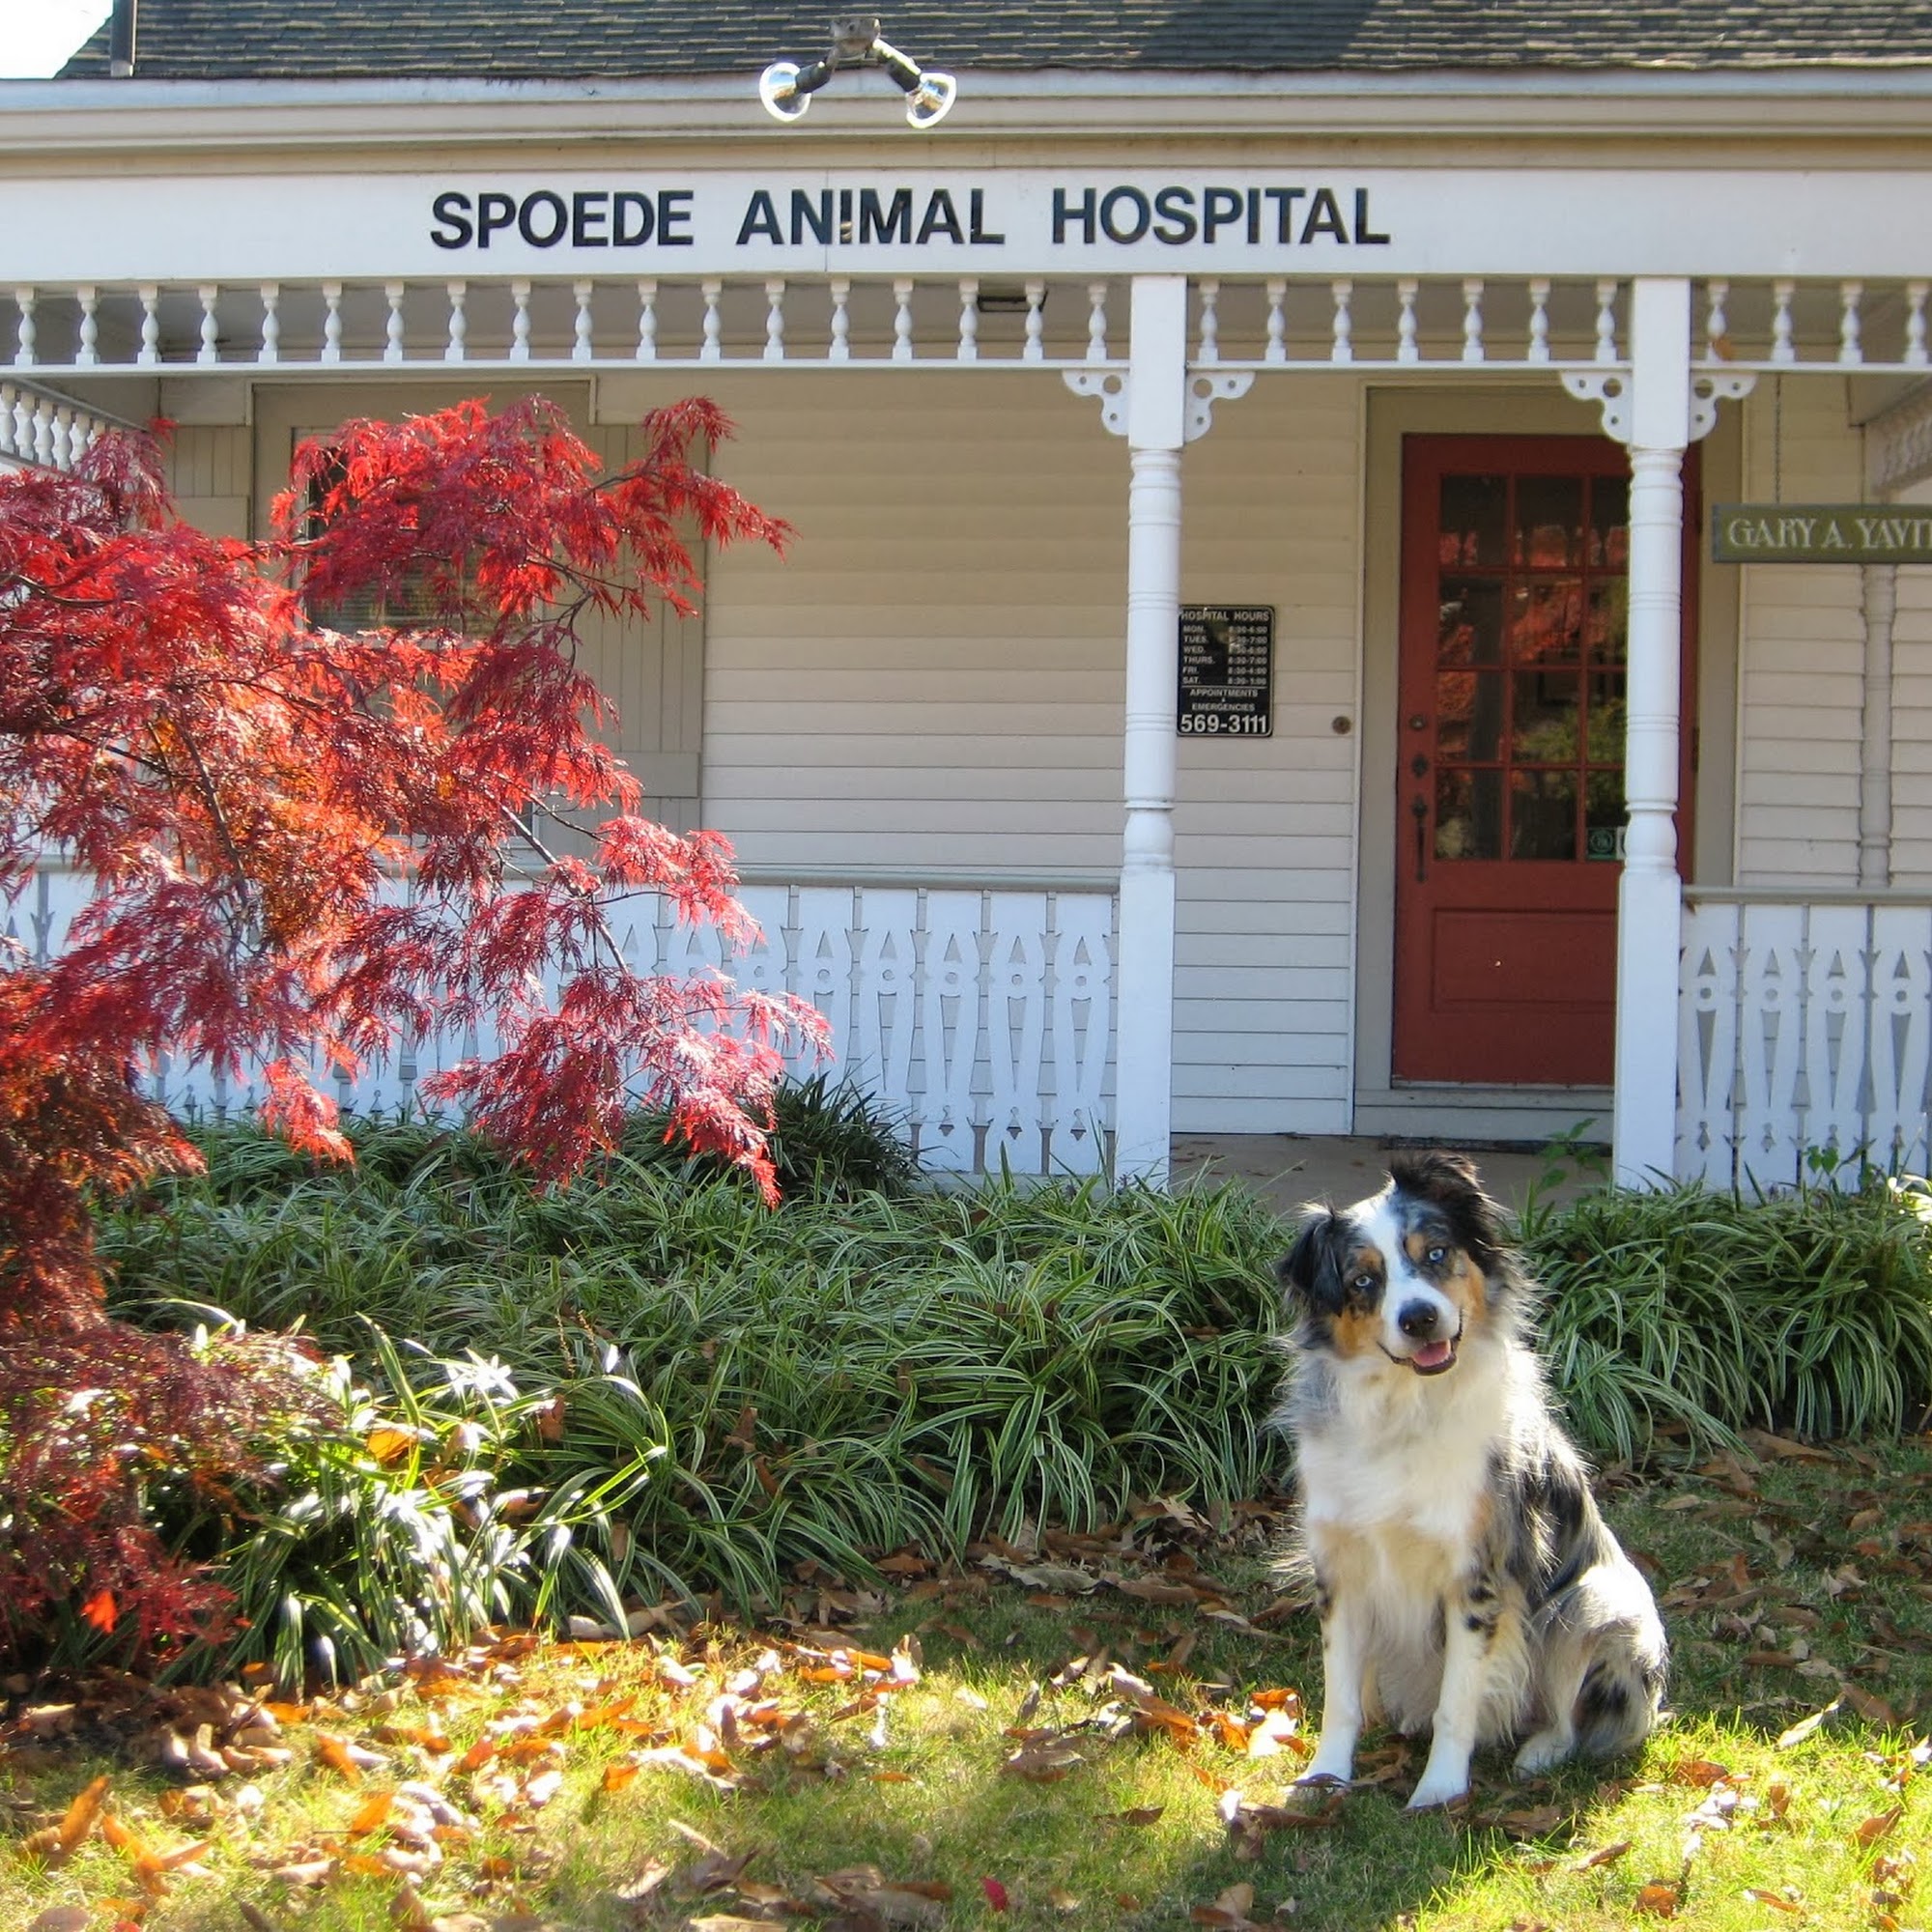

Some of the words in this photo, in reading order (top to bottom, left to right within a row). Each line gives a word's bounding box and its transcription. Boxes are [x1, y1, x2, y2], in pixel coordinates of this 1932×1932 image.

[431, 190, 694, 250] SPOEDE
[736, 188, 1005, 245] ANIMAL
[1053, 186, 1390, 245] HOSPITAL
[1728, 517, 1816, 548] GARY
[1821, 520, 1853, 549] A.
[1181, 611, 1230, 621] HOSPITAL
[1234, 611, 1269, 621] HOURS
[1189, 689, 1259, 697] APPOINTMENTS
[1191, 702, 1256, 711] EMERGENCIES
[1180, 714, 1266, 733] 569-3111
